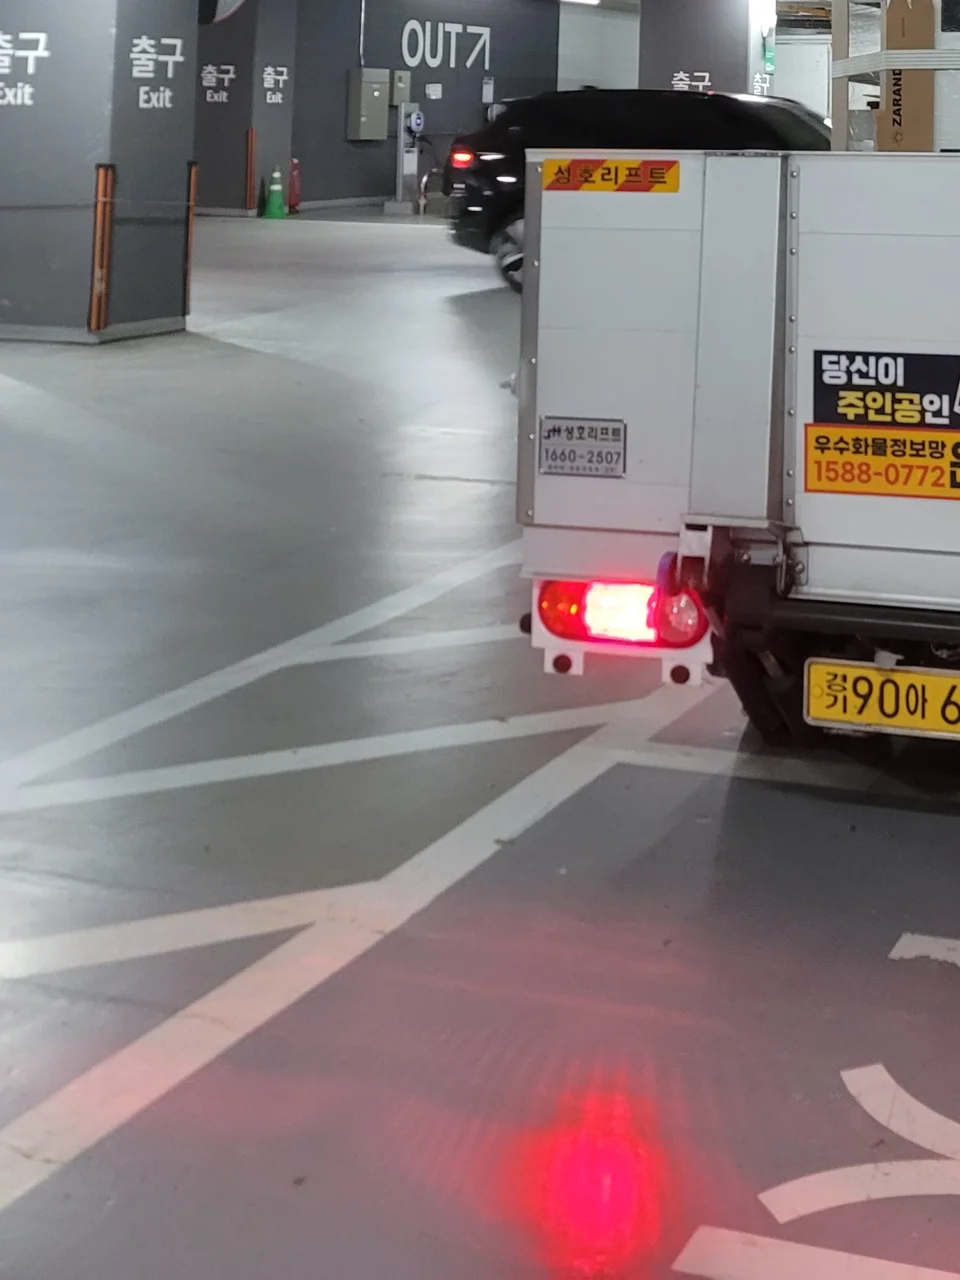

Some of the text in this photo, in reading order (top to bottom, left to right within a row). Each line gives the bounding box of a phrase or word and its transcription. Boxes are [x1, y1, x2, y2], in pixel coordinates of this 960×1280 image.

[402, 20, 463, 68] OUT
[130, 35, 184, 78] 출구
[201, 64, 236, 87] 출구
[262, 66, 288, 88] 출구
[671, 71, 711, 91] 출구
[138, 86, 173, 108] Exit
[206, 90, 228, 102] Exit
[266, 91, 283, 103] Exit
[892, 68, 902, 128] ZARAND
[553, 165, 667, 185] 성호리프트
[821, 354, 905, 387] 당신이
[837, 390, 950, 425] 주인공인
[814, 435, 947, 459] 우수화물정보망
[814, 460, 946, 489] 1588-0772
